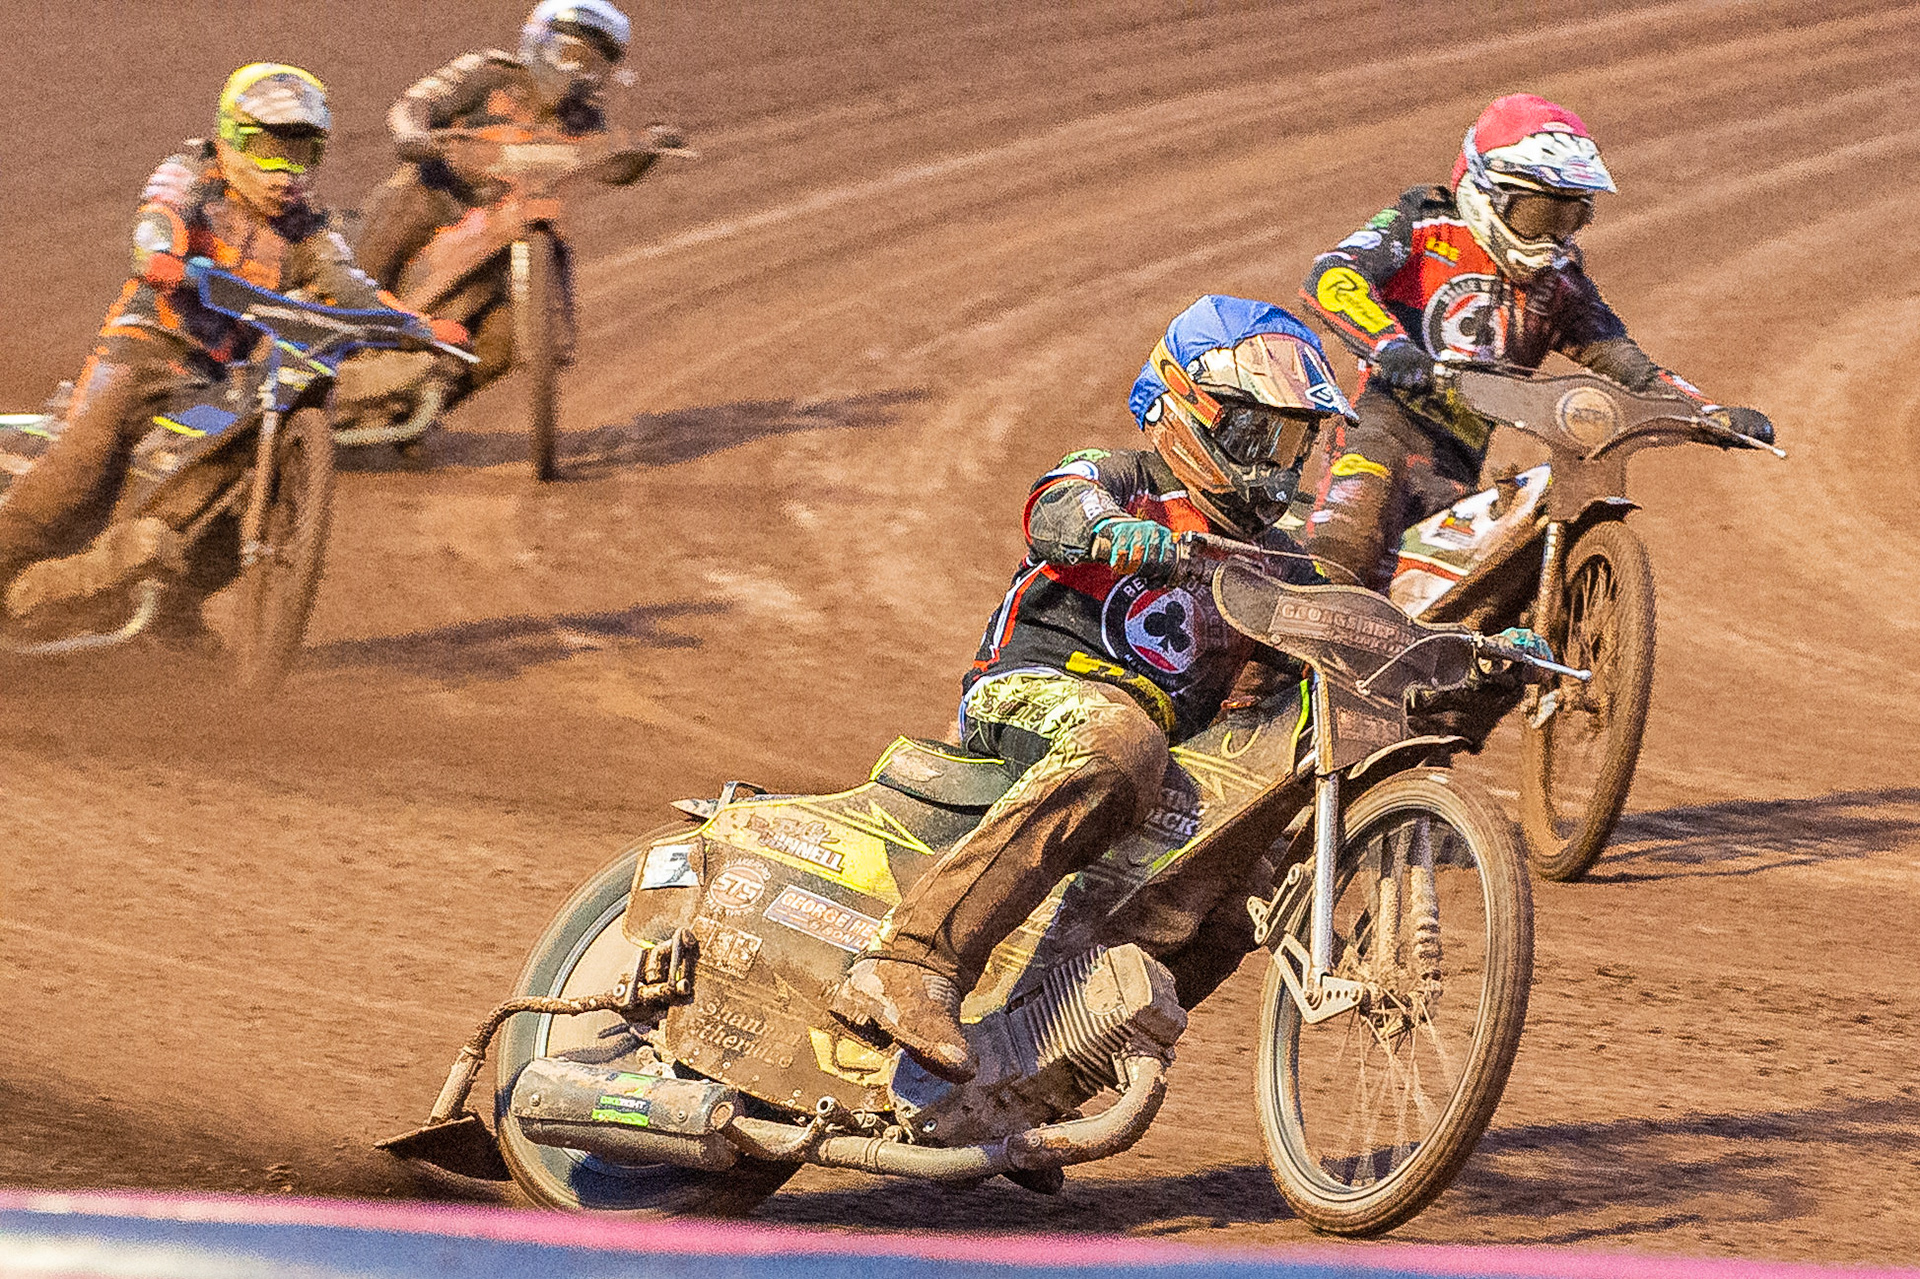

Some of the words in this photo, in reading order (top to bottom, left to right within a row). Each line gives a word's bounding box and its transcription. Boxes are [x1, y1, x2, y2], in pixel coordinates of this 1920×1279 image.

[712, 871, 763, 901] STS
[780, 892, 852, 928] GEORGE
[821, 926, 855, 944] SON
